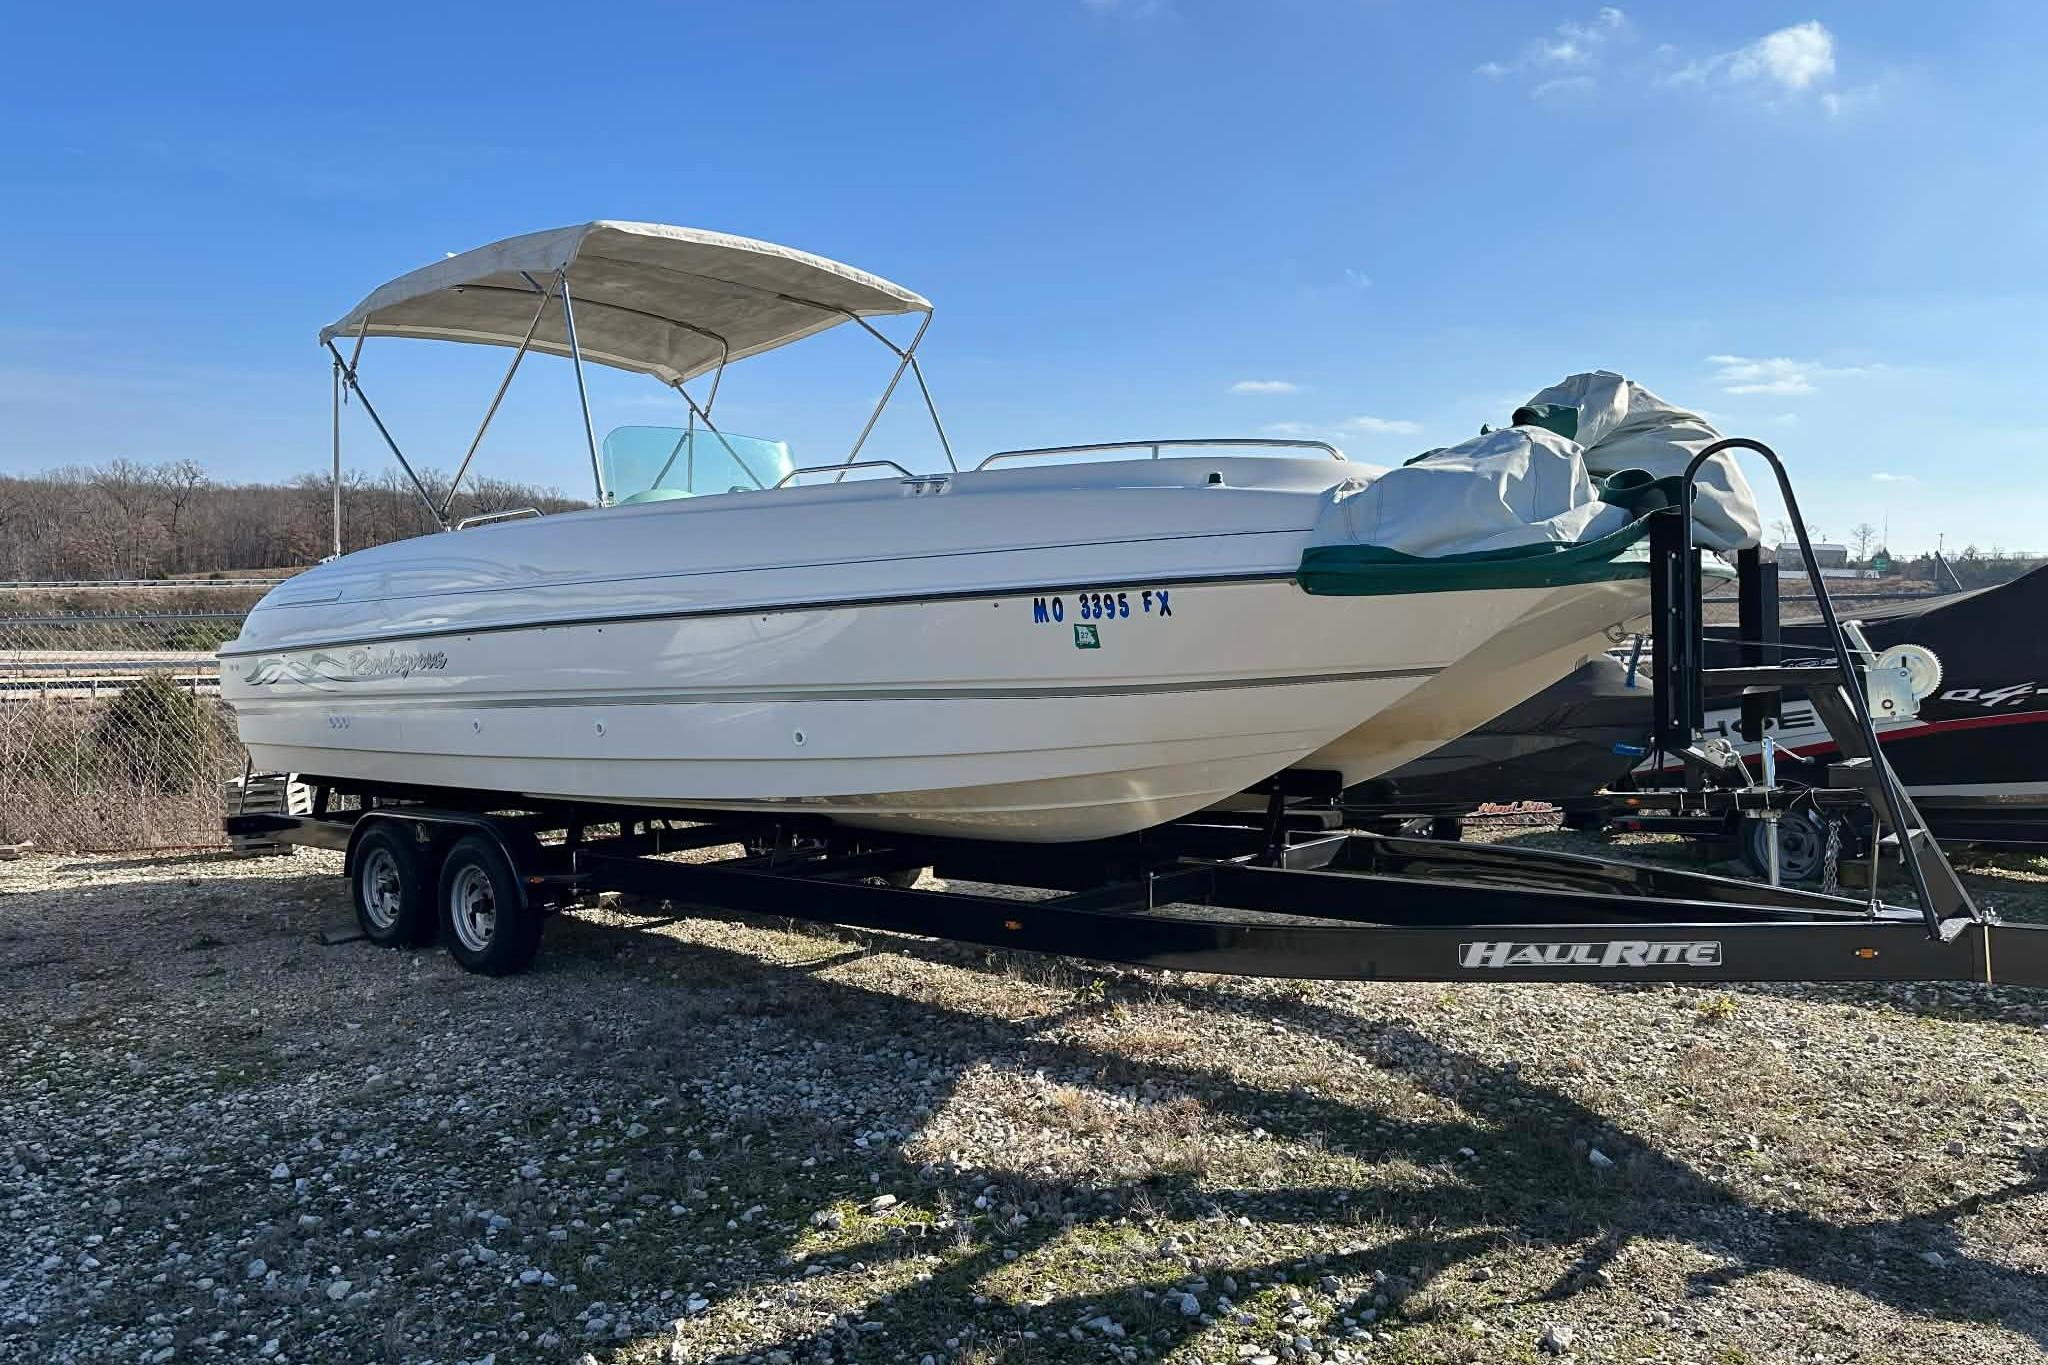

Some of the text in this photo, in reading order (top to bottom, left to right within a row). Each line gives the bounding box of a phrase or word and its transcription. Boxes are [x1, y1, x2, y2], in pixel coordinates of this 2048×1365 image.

[1033, 590, 1172, 623] MO 3395 FX
